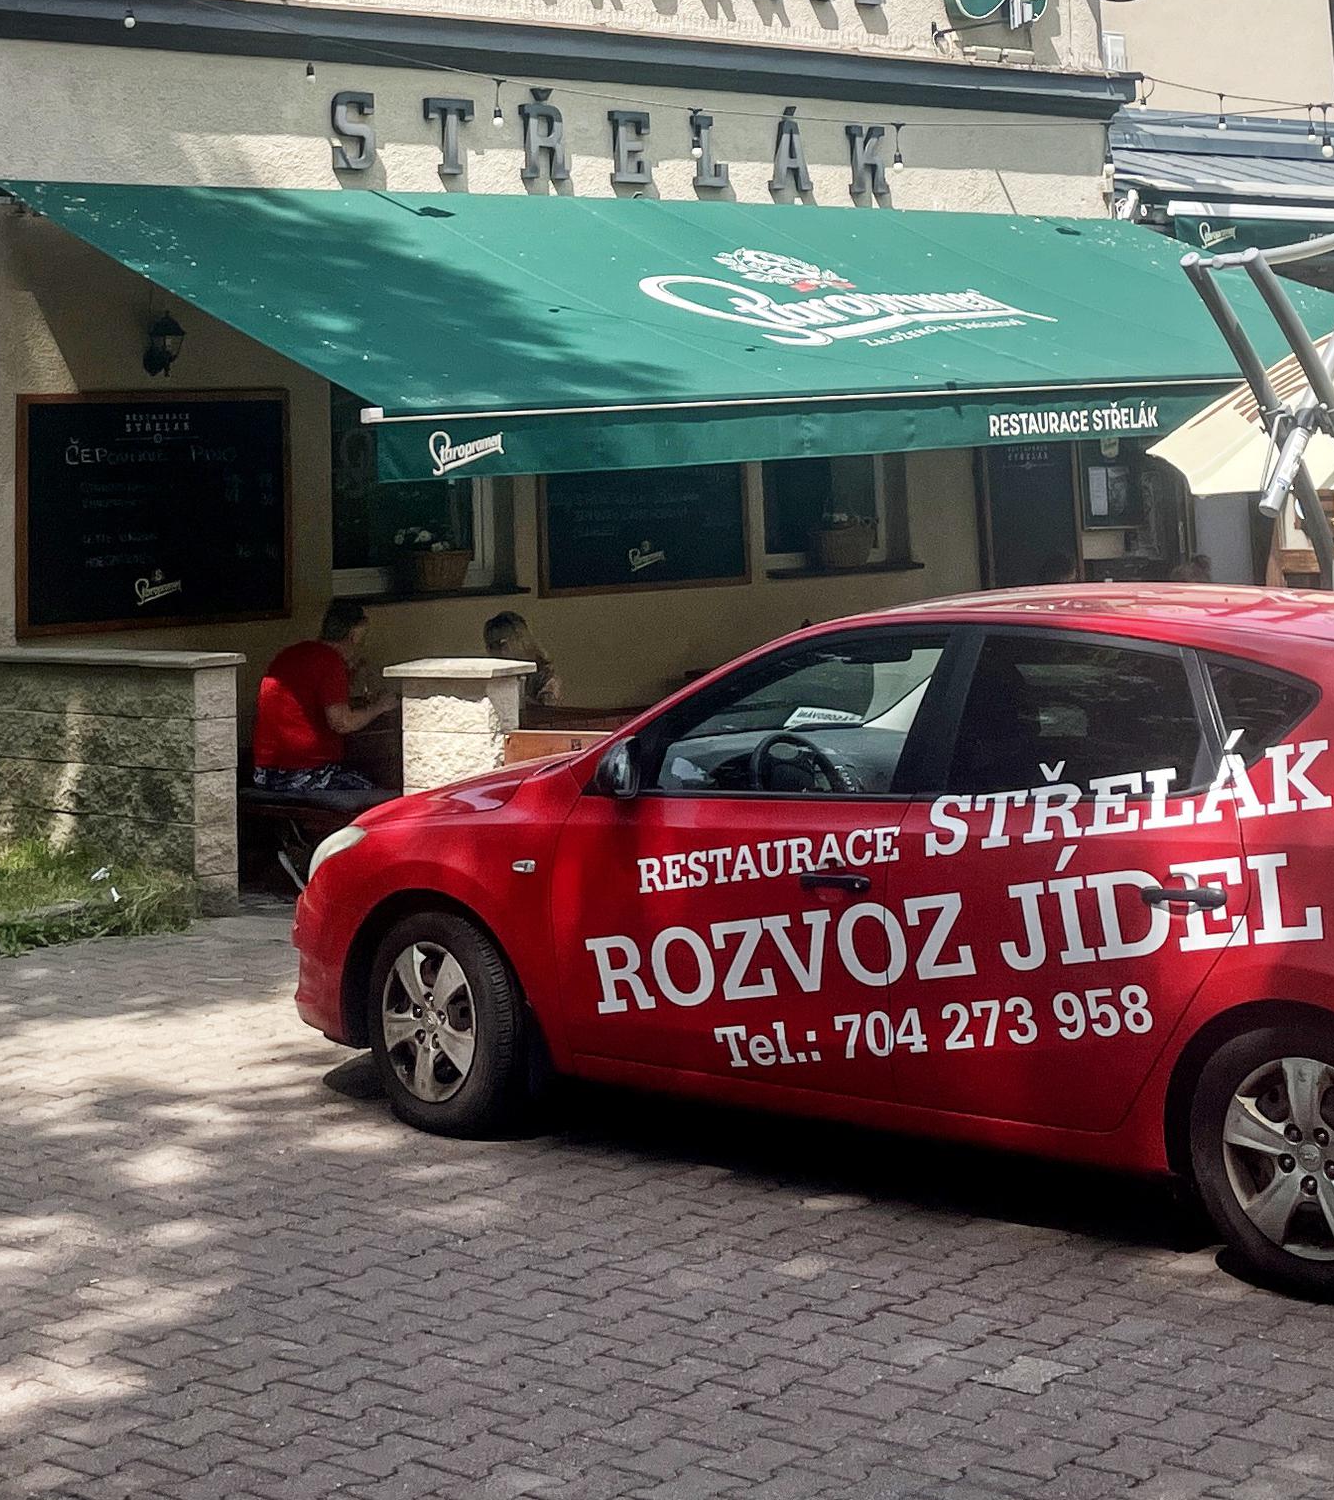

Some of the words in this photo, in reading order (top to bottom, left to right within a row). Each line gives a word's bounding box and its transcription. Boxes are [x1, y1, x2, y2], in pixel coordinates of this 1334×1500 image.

[331, 88, 890, 195] STŘELÁK
[429, 431, 505, 476] Staropramen
[989, 410, 1089, 437] RESTAURACE
[1092, 401, 1158, 431] STŘELÁK
[637, 826, 901, 893] RESTAURACE
[924, 729, 1332, 859] STŘELÁK
[585, 892, 975, 1015] ROZVOZ
[1000, 845, 1324, 972] JÍDEL
[714, 1025, 820, 1068] Tel.:
[834, 1008, 928, 1060] 704
[941, 996, 1038, 1051] 273
[1057, 985, 1153, 1041] 958
